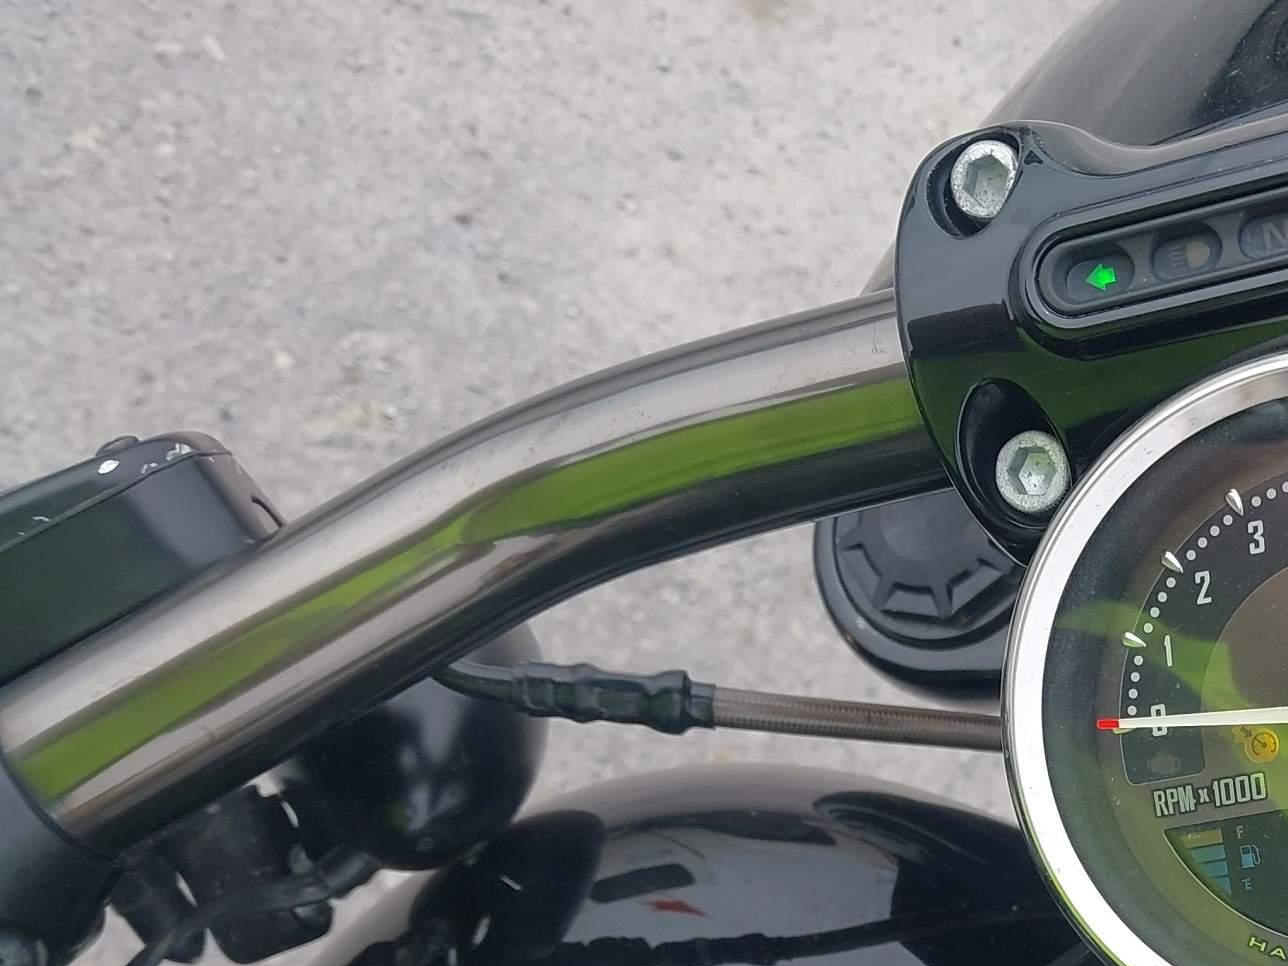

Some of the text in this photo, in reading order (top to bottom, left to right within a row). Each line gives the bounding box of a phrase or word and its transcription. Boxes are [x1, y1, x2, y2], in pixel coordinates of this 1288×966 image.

[1247, 520, 1266, 555] 3
[1194, 571, 1213, 605] 2
[1162, 635, 1173, 667] 1
[1153, 784, 1196, 817] RPM
[1212, 772, 1268, 807] 1000
